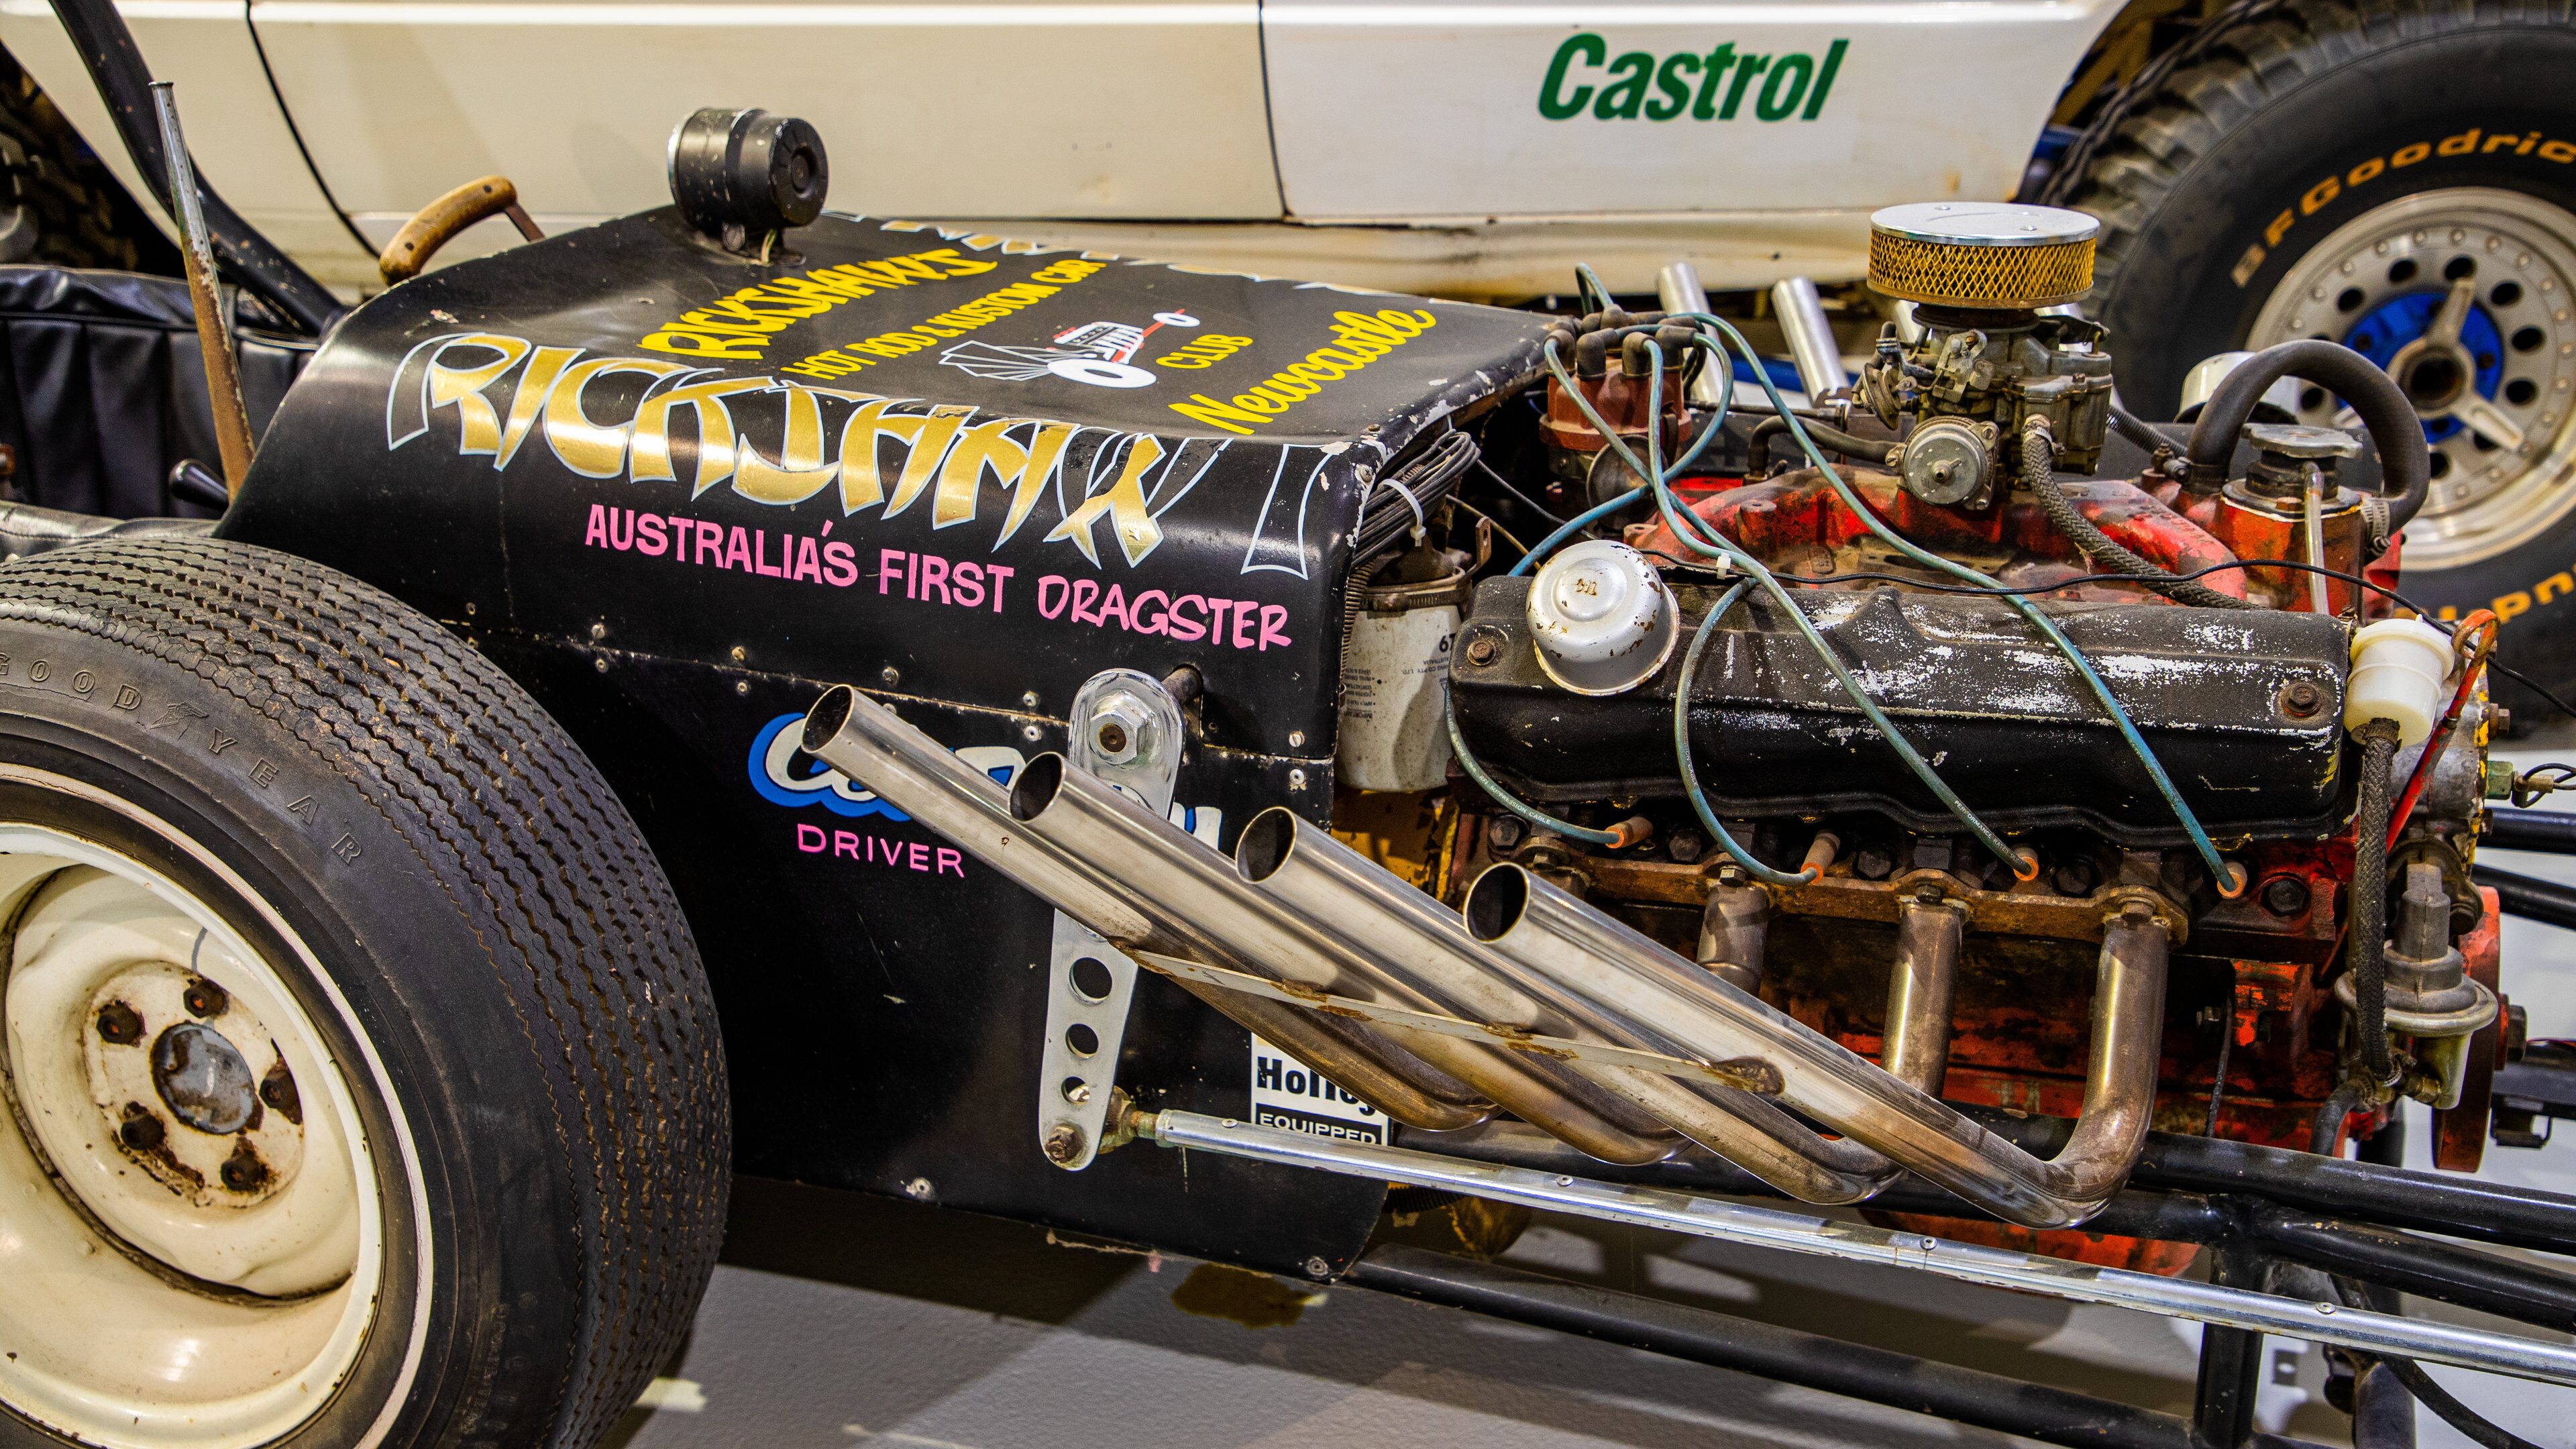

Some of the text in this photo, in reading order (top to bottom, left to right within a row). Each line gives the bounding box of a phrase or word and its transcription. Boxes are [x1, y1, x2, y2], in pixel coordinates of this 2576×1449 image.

[1538, 32, 1849, 121] Castrol
[780, 259, 1107, 380] HOT ROD & KUSTOM CAR
[1156, 333, 1254, 370] CLUB
[1169, 308, 1437, 435] Newcastle
[585, 503, 1292, 651] AUSTRALIA'S FIRST DRAGSTER
[1529, 812, 1552, 826] CABLE
[1954, 800, 1992, 840] PERFORMANCE
[1992, 839, 2009, 855] RATED
[797, 823, 965, 878] DRIVER
[1257, 1056, 1377, 1116] Holl
[1260, 1112, 1377, 1144] EQUIPPED
